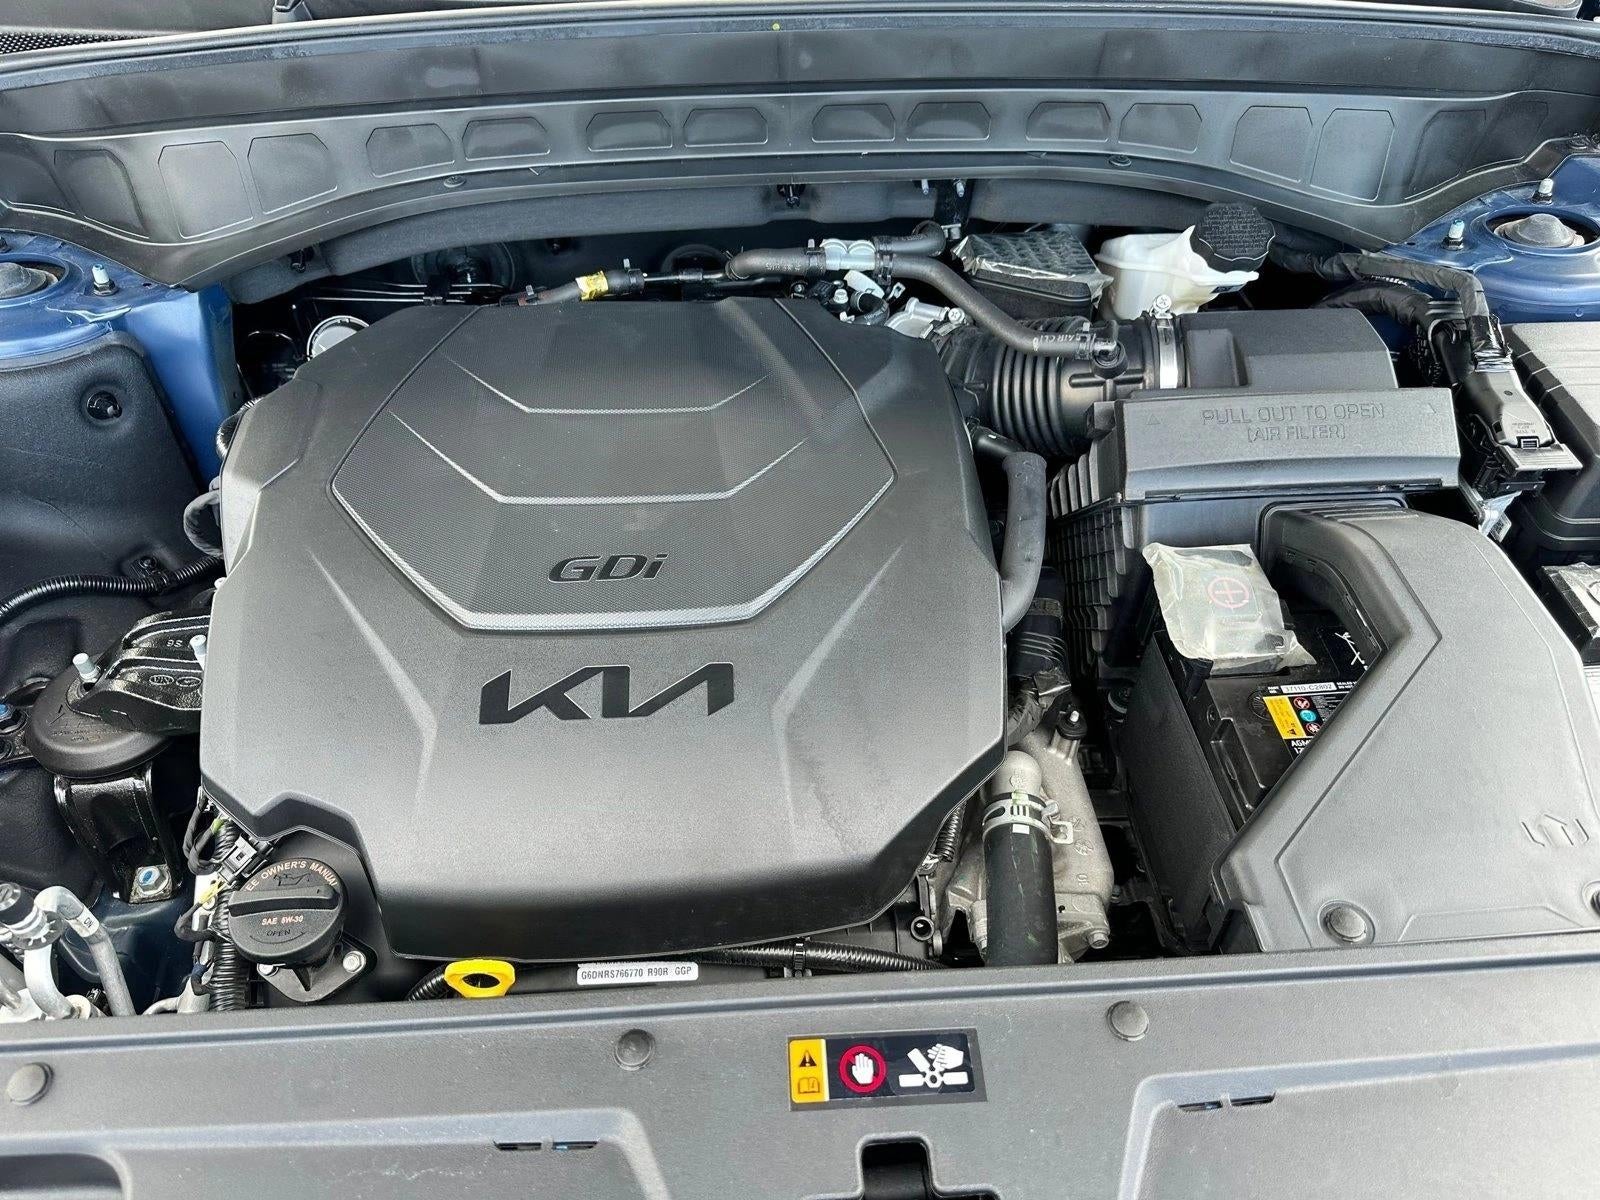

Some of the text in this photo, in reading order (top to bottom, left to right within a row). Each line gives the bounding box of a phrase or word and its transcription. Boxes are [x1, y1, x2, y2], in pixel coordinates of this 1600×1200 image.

[1201, 402, 1385, 425] PULL OUT TO OPEN
[548, 554, 669, 583] GDi
[479, 661, 735, 725] KIA
[245, 879, 260, 892] EE
[260, 861, 307, 879] OWNER'S
[261, 915, 304, 926] SAE 5W-30
[674, 966, 692, 976] GGP
